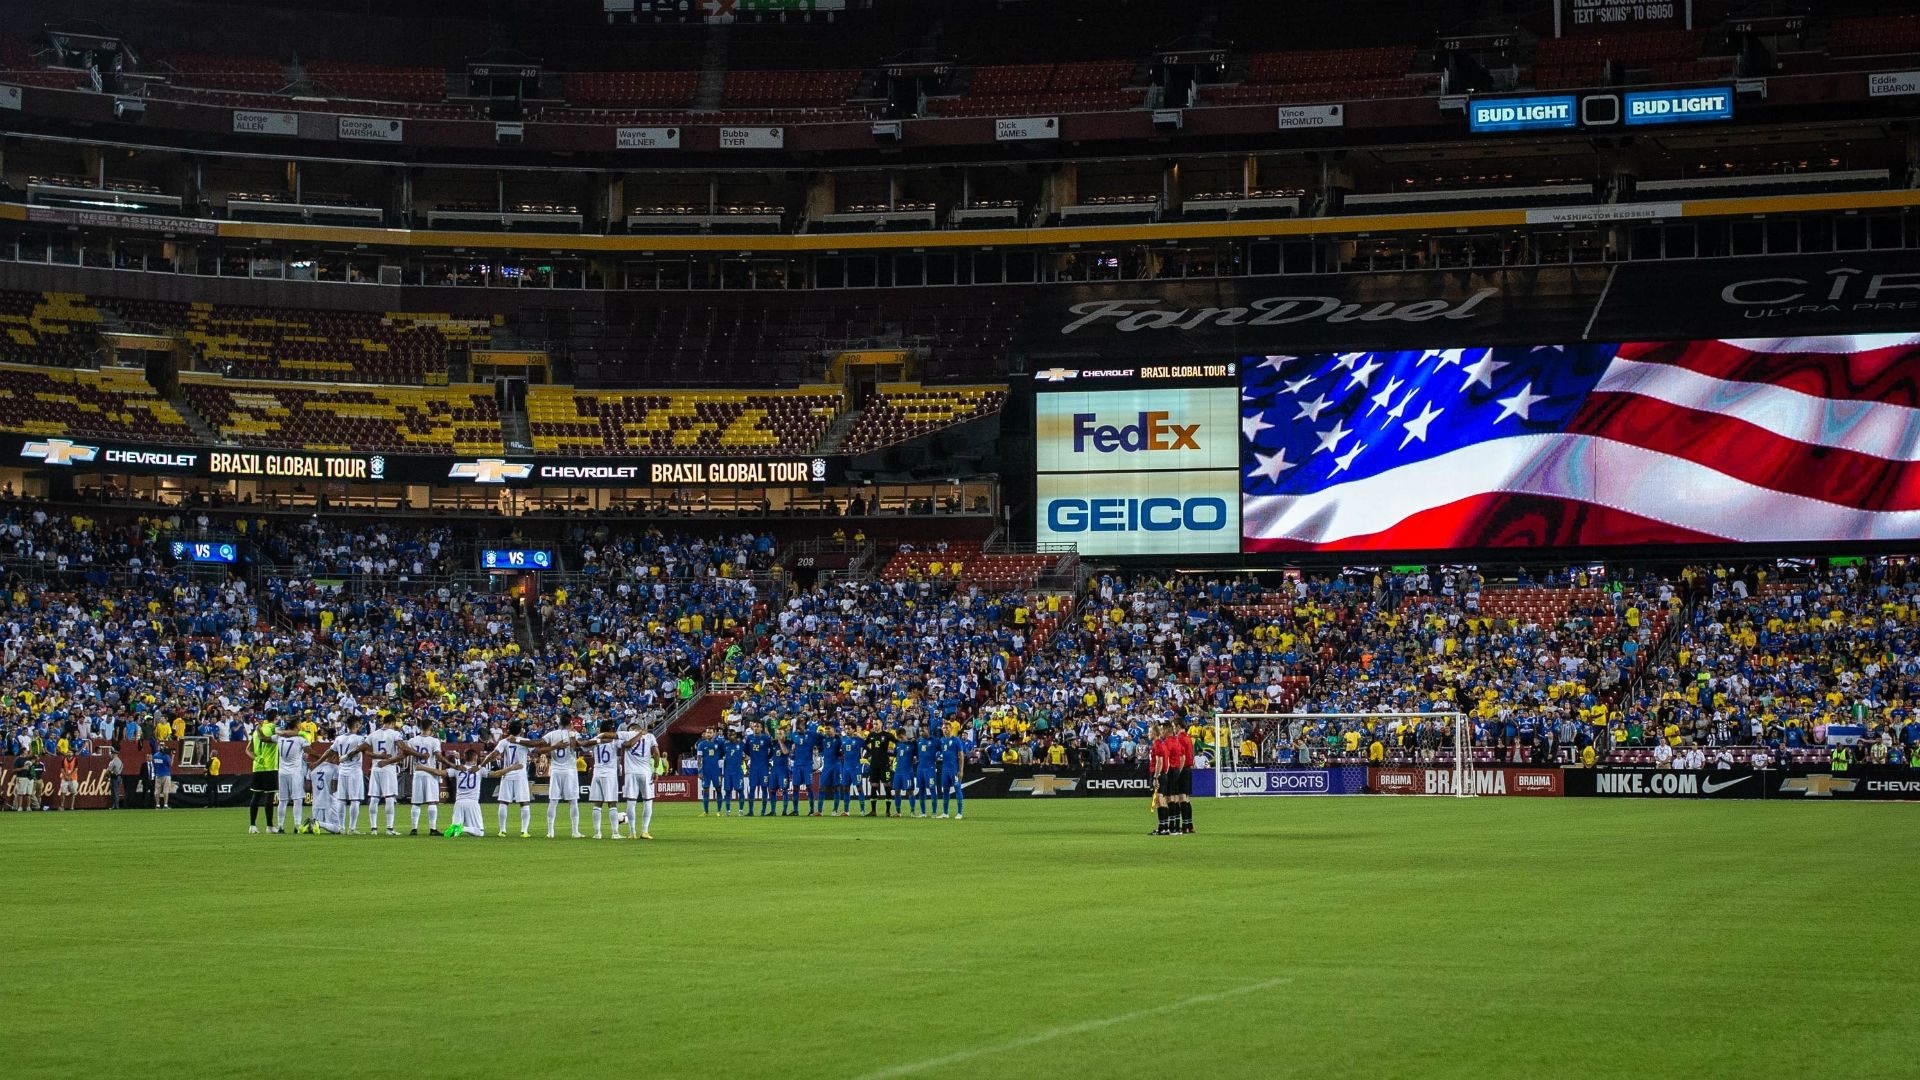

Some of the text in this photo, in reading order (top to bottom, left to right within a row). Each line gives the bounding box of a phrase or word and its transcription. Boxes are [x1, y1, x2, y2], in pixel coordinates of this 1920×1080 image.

[1573, 9, 1594, 24] TEXT
[1634, 5, 1644, 20] TO
[1646, 4, 1673, 19] 69050
[1871, 75, 1897, 84] Eddie
[1871, 84, 1916, 94] LEBARON
[1632, 97, 1723, 115] BUD LIGHT
[235, 113, 268, 125] George
[1477, 105, 1568, 123] BUD LIGHT
[235, 122, 264, 132] ALLEN
[341, 119, 373, 131] George
[998, 121, 1017, 129] Dick
[1281, 117, 1324, 126] PROMUTO
[341, 128, 387, 139] MARSHALL
[619, 130, 646, 141] Wayne
[722, 130, 749, 138] Bubba
[998, 129, 1027, 138] JAMES
[618, 138, 655, 146] MILLNER
[722, 138, 745, 146] TYER
[79, 212, 117, 221] NEED
[1553, 210, 1656, 220] WASHINGTON REDSKINS
[1061, 287, 1499, 334] FanDuel
[1744, 303, 1840, 319] ULTRA
[1082, 369, 1135, 378] CHEVROLET
[1171, 365, 1203, 378] GLOBAL
[1204, 364, 1226, 377] TOUR
[1073, 411, 1201, 452] FedEx
[105, 449, 197, 466] CHEVROLET
[266, 455, 323, 477] GLOBAL
[325, 457, 367, 479] TOUR
[540, 466, 638, 478] CHEVROLET
[709, 463, 766, 483] GLOBAL
[768, 462, 808, 482] TOUR
[1047, 497, 1227, 532] GEICO
[195, 543, 210, 558] VS
[508, 551, 524, 565] VS
[797, 557, 815, 567] 208
[280, 739, 294, 758] 17
[597, 744, 610, 764] 16
[630, 738, 645, 758] 21
[752, 744, 760, 752] 22
[508, 745, 517, 764] 7
[316, 771, 325, 791] 3
[458, 771, 476, 789] 20
[1086, 779, 1150, 790] CHEVROL
[1221, 773, 1324, 789] beIN SPORTS
[1380, 774, 1412, 785] BRAHMA
[1425, 770, 1506, 794] BRAHMA
[1518, 775, 1550, 786] BRAHMA
[1596, 773, 1698, 794] NIKE.COM
[182, 783, 233, 793] CHEVLET
[657, 782, 686, 792] BRAHMA
